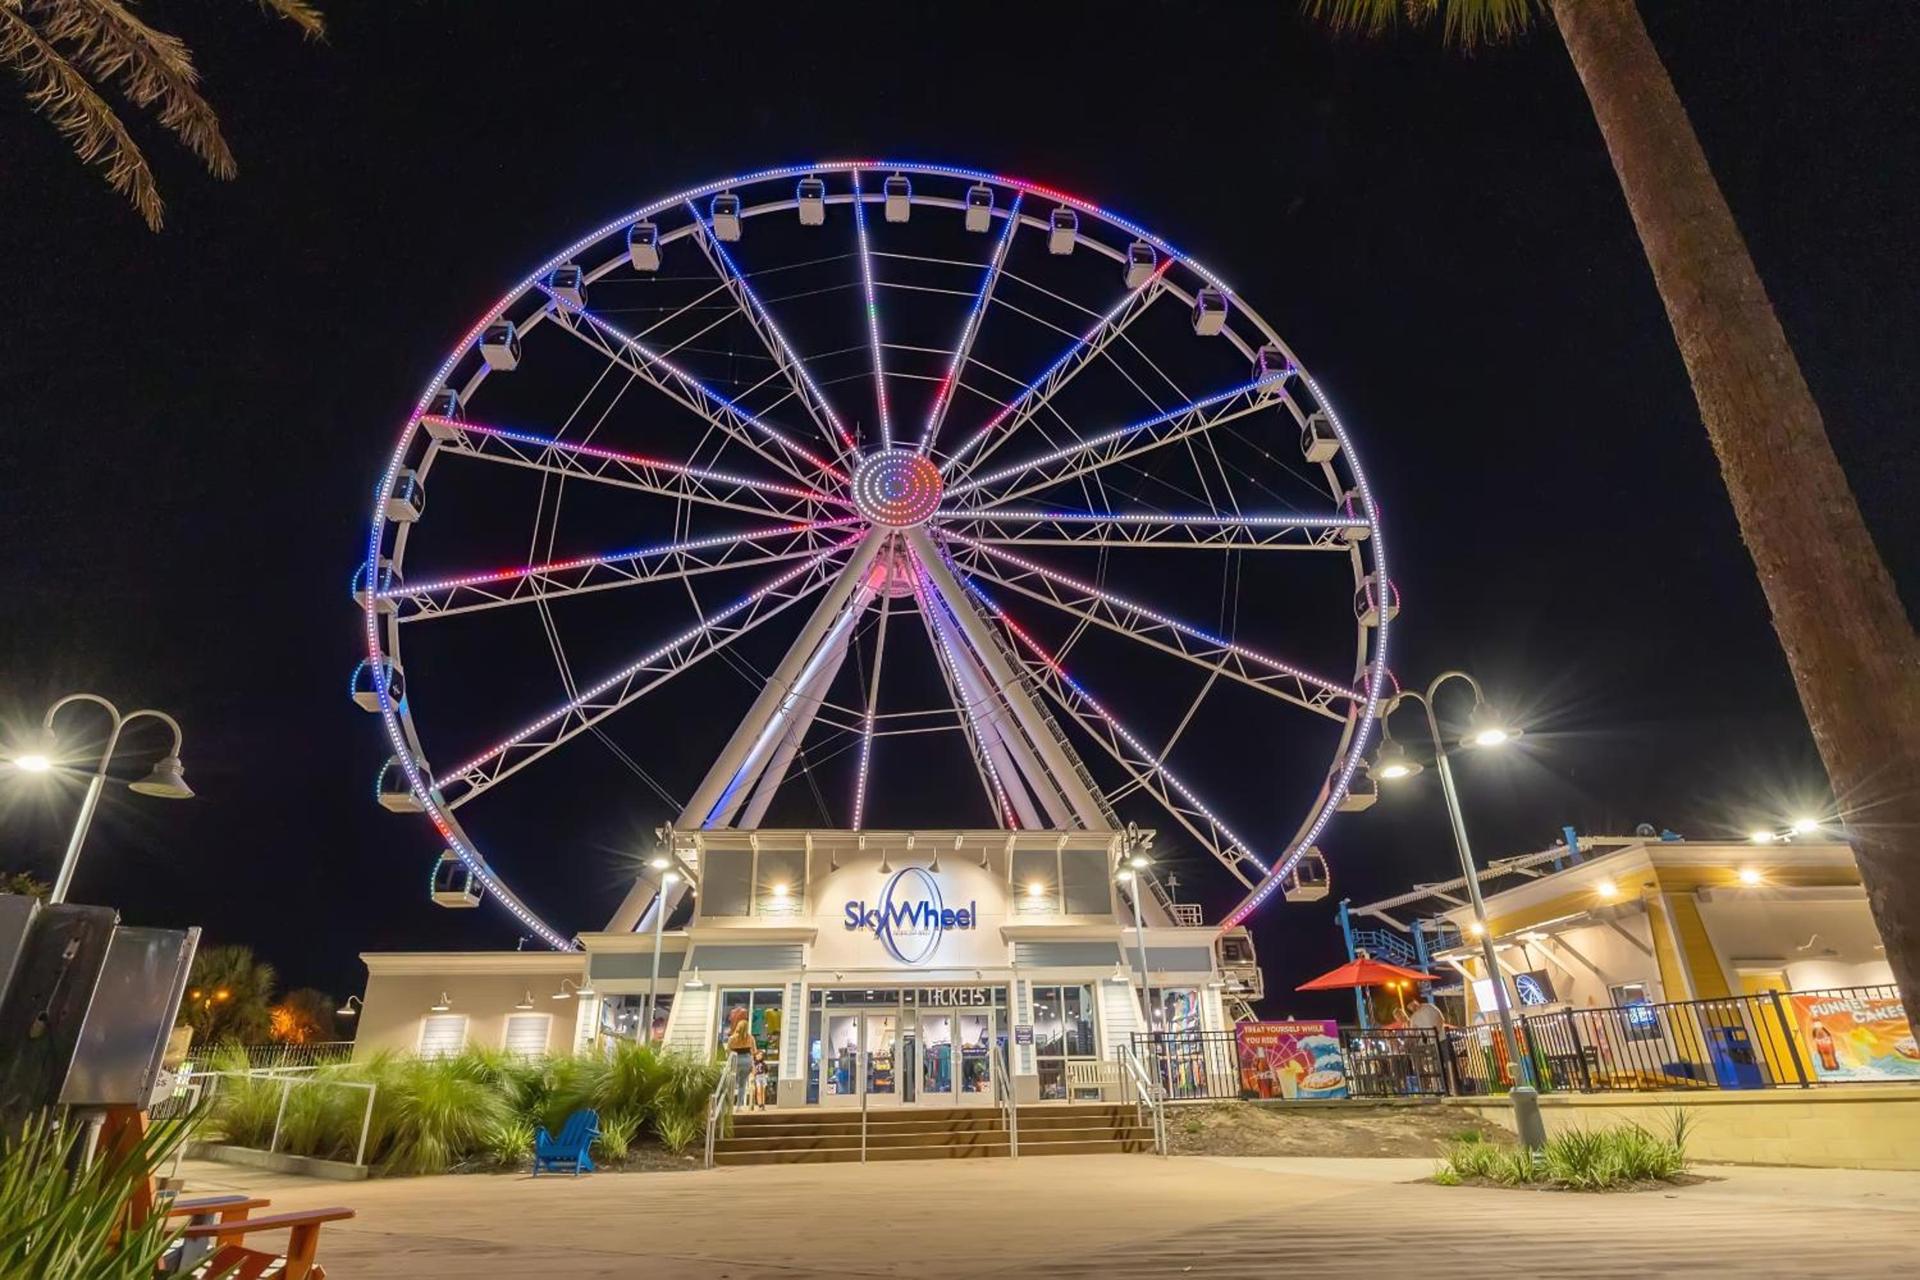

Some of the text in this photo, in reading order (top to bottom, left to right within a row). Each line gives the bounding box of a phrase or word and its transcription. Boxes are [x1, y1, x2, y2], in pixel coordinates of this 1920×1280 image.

[844, 900, 977, 938] SkyWheel
[927, 987, 986, 1006] TICKETS
[1809, 999, 1870, 1018] FUNNEL
[1244, 1024, 1325, 1034] TREAT YOURSELF WHILE
[1246, 1036, 1260, 1045] YOU
